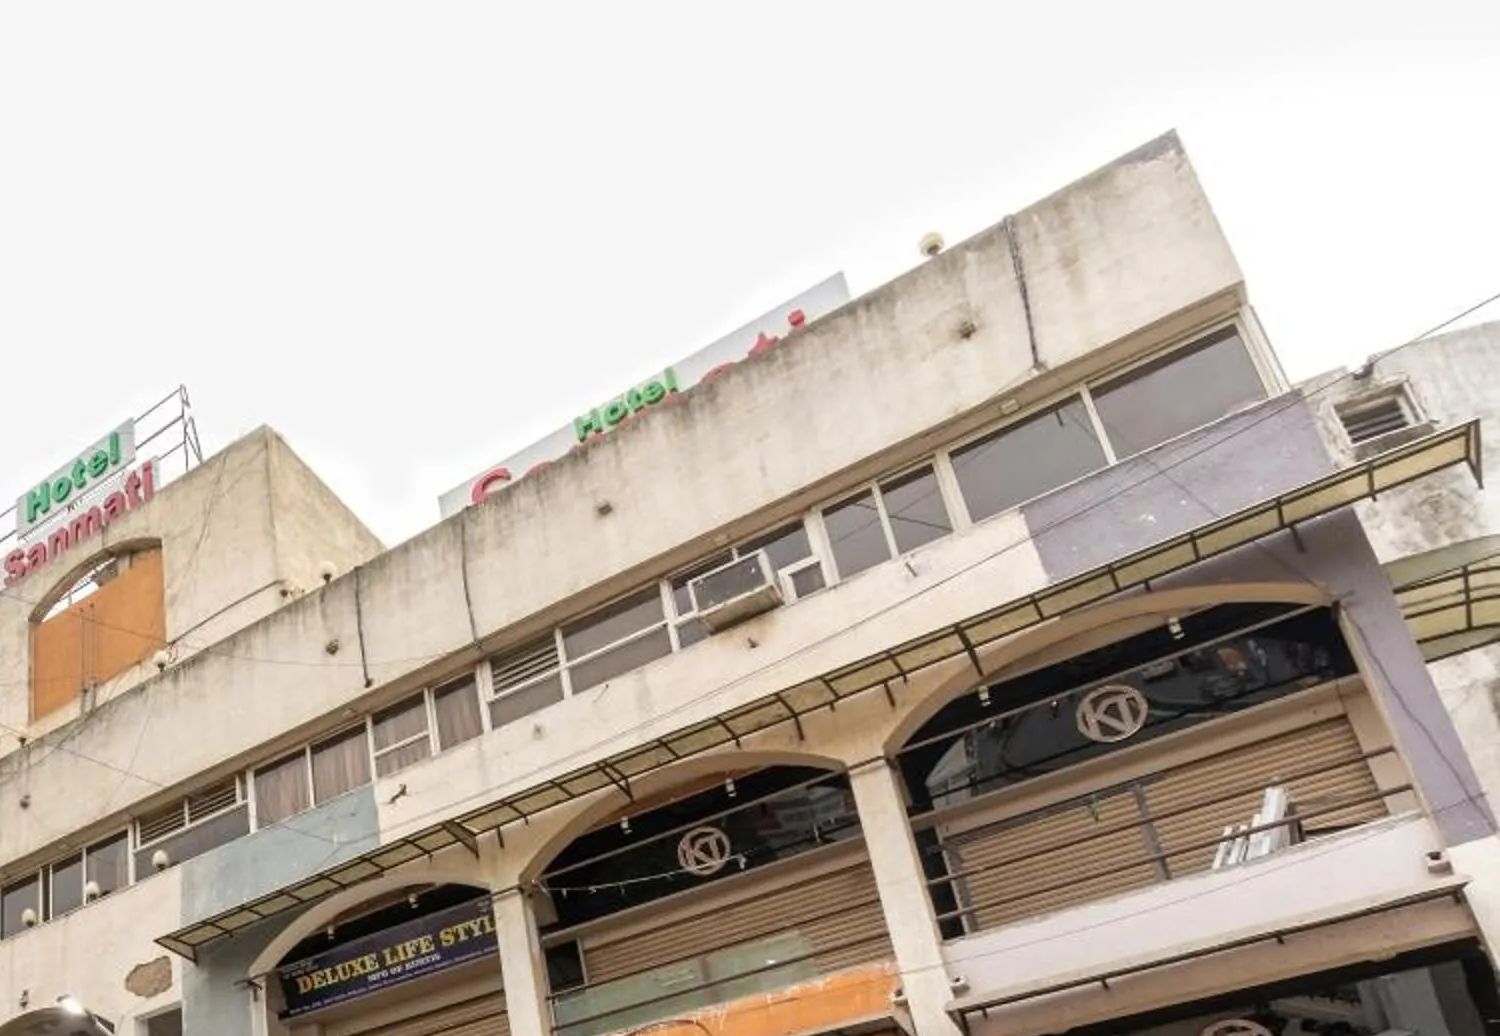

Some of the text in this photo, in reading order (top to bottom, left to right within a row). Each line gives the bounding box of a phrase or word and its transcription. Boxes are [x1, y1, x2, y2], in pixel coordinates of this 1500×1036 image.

[572, 365, 679, 442] Hotel
[26, 431, 121, 524] Hotel
[3, 460, 155, 584] Sanmati
[296, 953, 379, 994] DELUXE
[382, 934, 436, 966] LIFE
[439, 914, 496, 947] STYL
